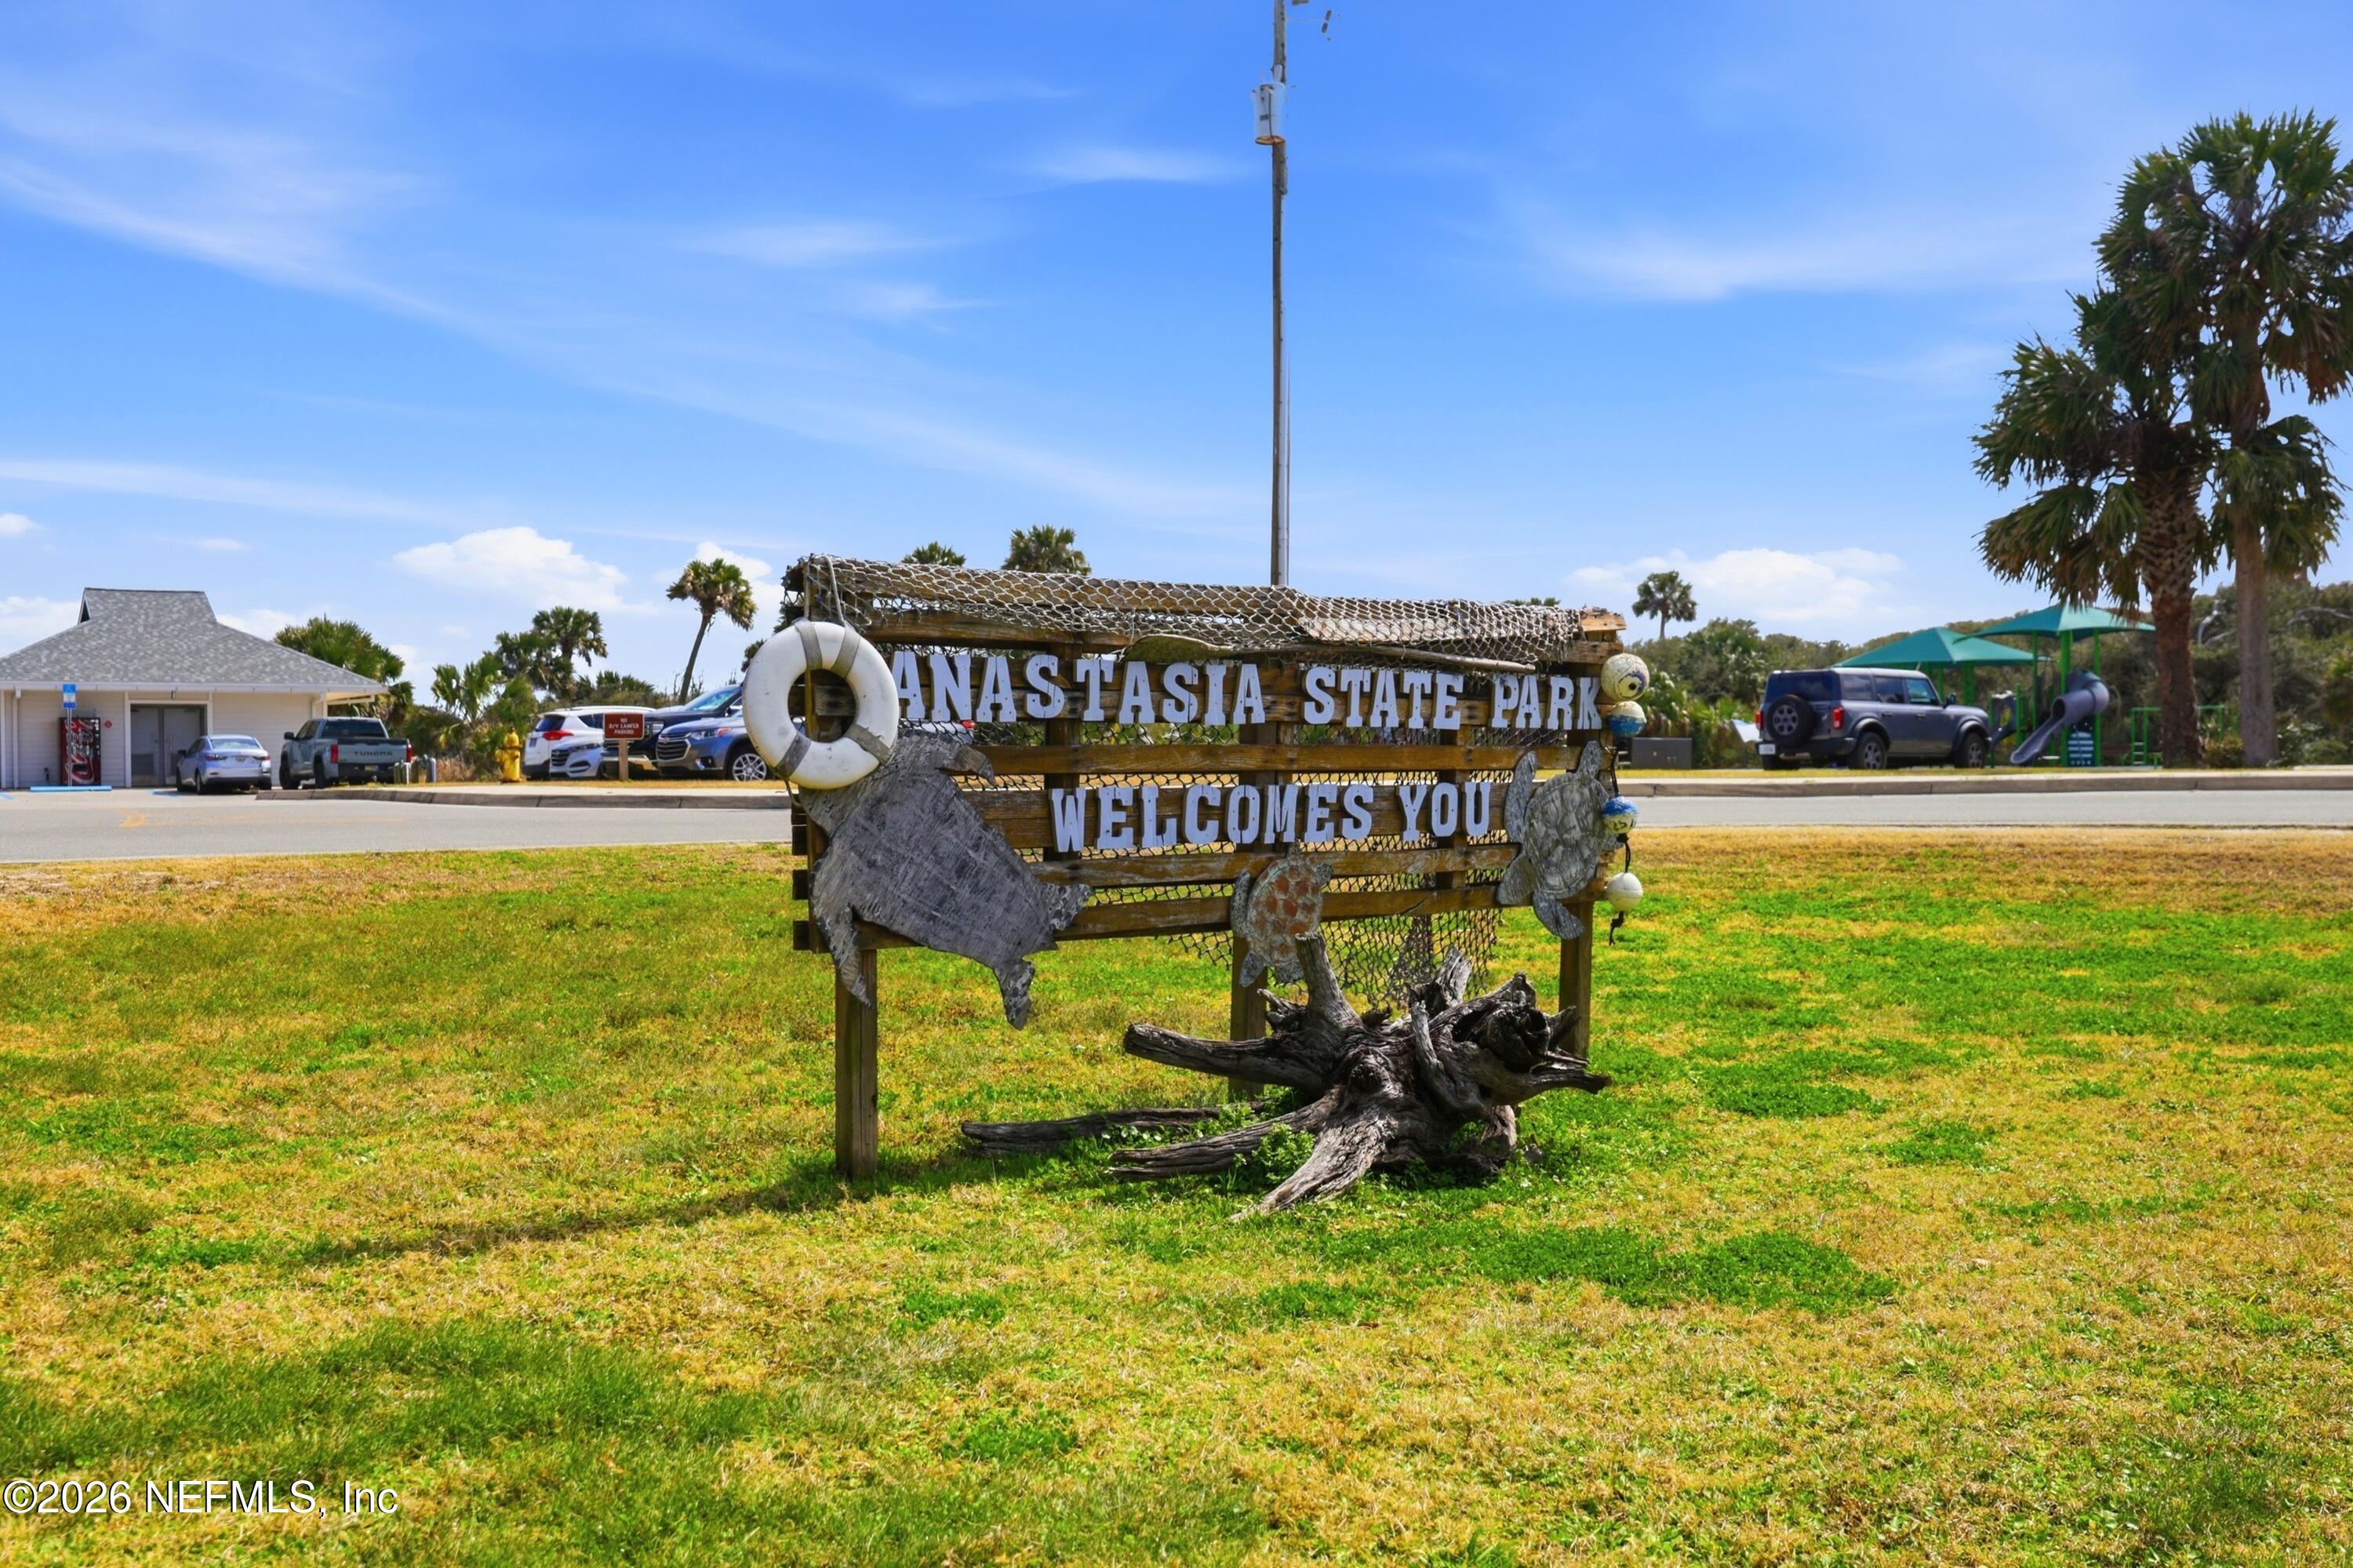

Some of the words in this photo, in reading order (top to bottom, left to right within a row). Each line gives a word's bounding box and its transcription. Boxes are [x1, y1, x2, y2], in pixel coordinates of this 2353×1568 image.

[890, 650, 1266, 726] ANASTASIA
[1303, 667, 1464, 730] STATE
[1492, 674, 1602, 730] PARK
[1049, 782, 1374, 853] WELCOMES
[1398, 781, 1491, 842] YOU
